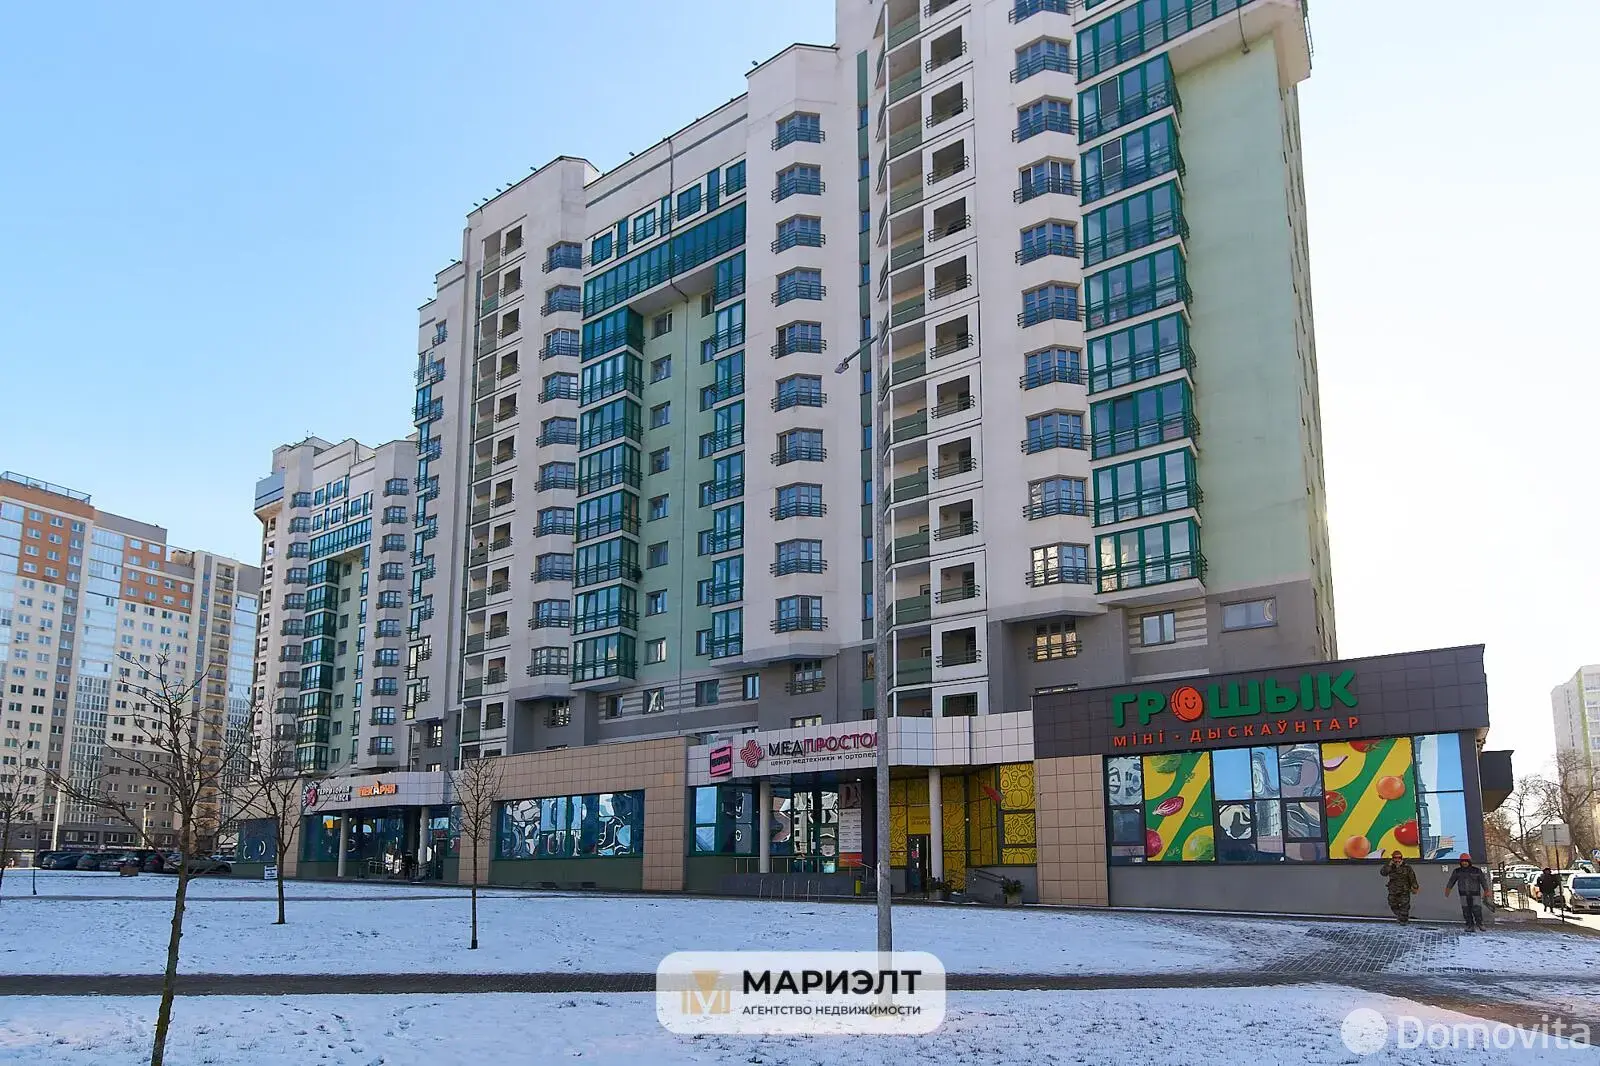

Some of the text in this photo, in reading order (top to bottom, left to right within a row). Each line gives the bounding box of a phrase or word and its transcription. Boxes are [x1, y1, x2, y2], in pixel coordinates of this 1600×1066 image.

[1112, 669, 1358, 728] ГРОШЫК
[1190, 716, 1360, 743] ДЫСКАЎНТАР
[768, 732, 878, 757] МЕДПРОСТО
[770, 759, 791, 767] центр
[792, 755, 835, 765] медтехники
[845, 752, 877, 760] ортопед
